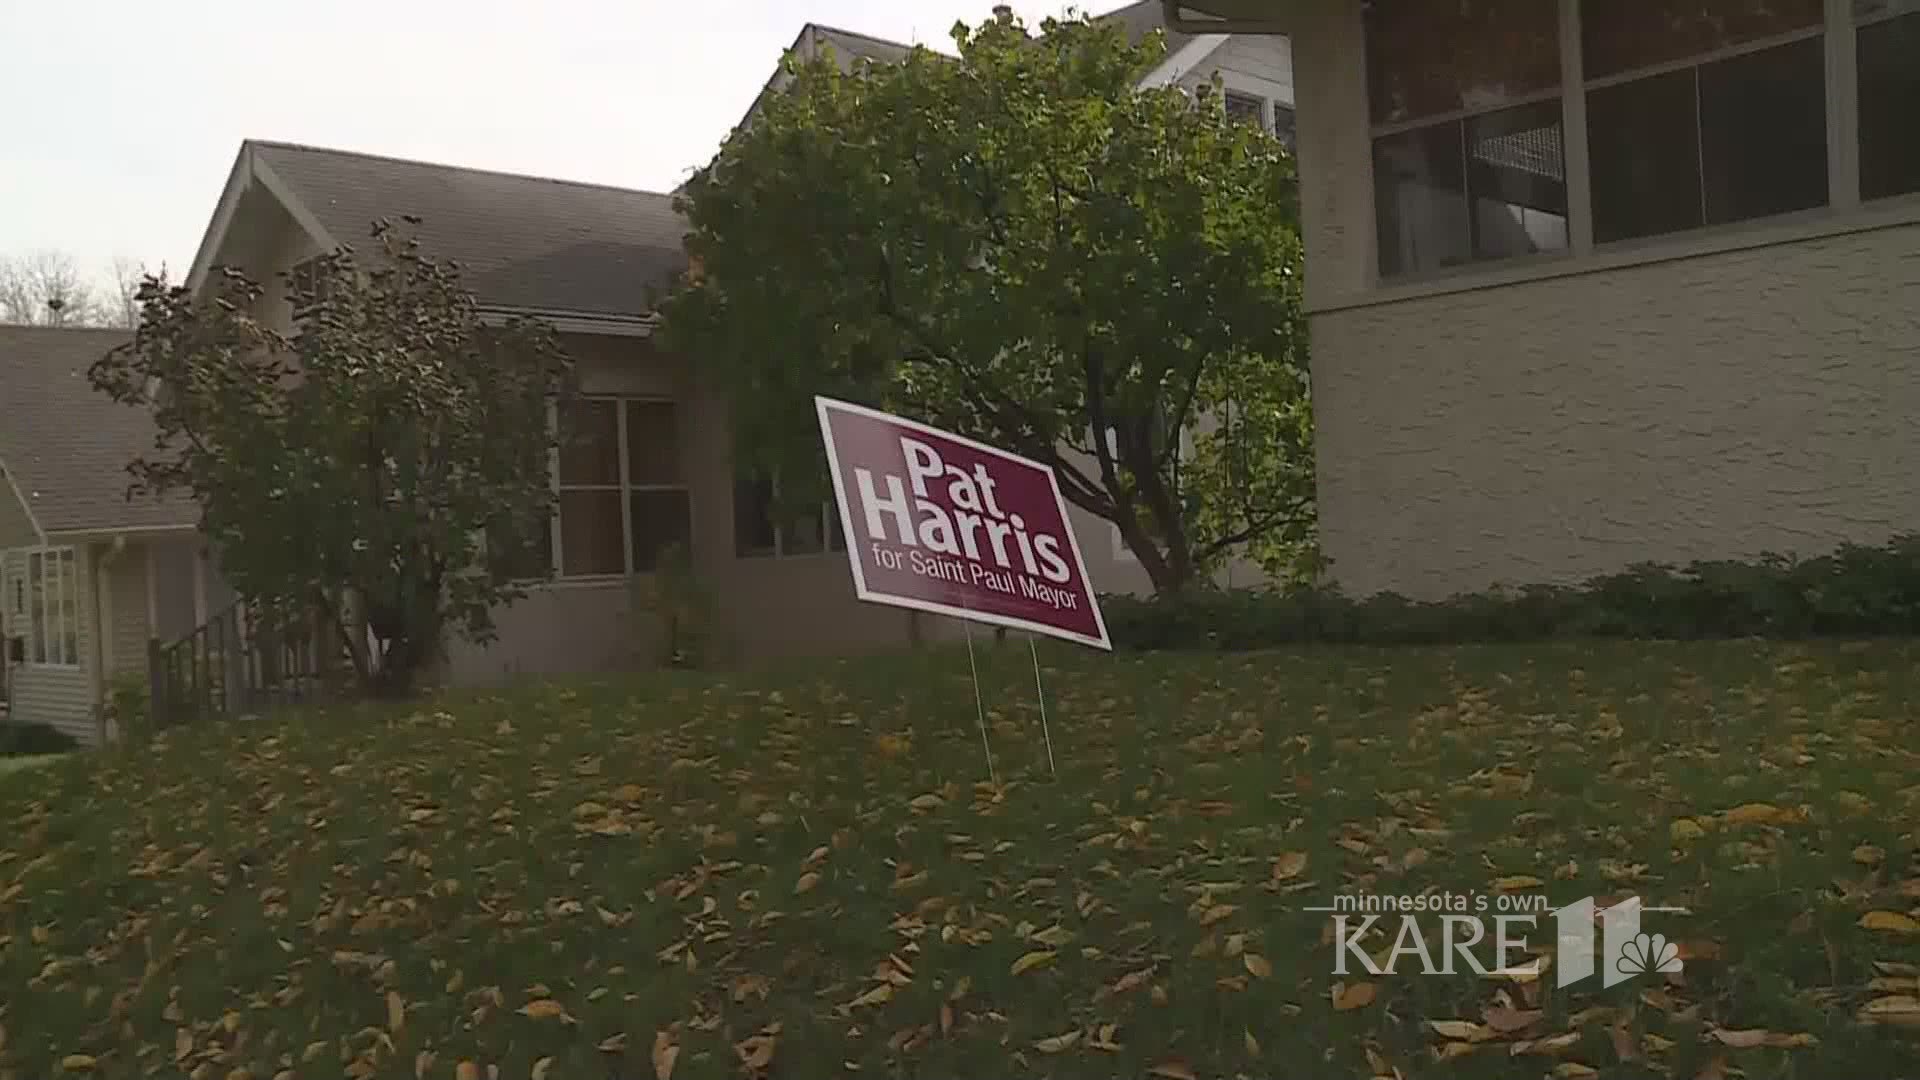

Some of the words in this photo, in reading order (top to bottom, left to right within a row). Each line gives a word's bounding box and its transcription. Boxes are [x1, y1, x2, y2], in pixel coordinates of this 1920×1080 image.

[900, 436, 1005, 519] Pat
[854, 467, 1071, 583] Harris
[872, 543, 904, 570] for
[909, 550, 968, 584] Saint
[969, 564, 1016, 595] Paul
[1018, 575, 1078, 610] Mayor
